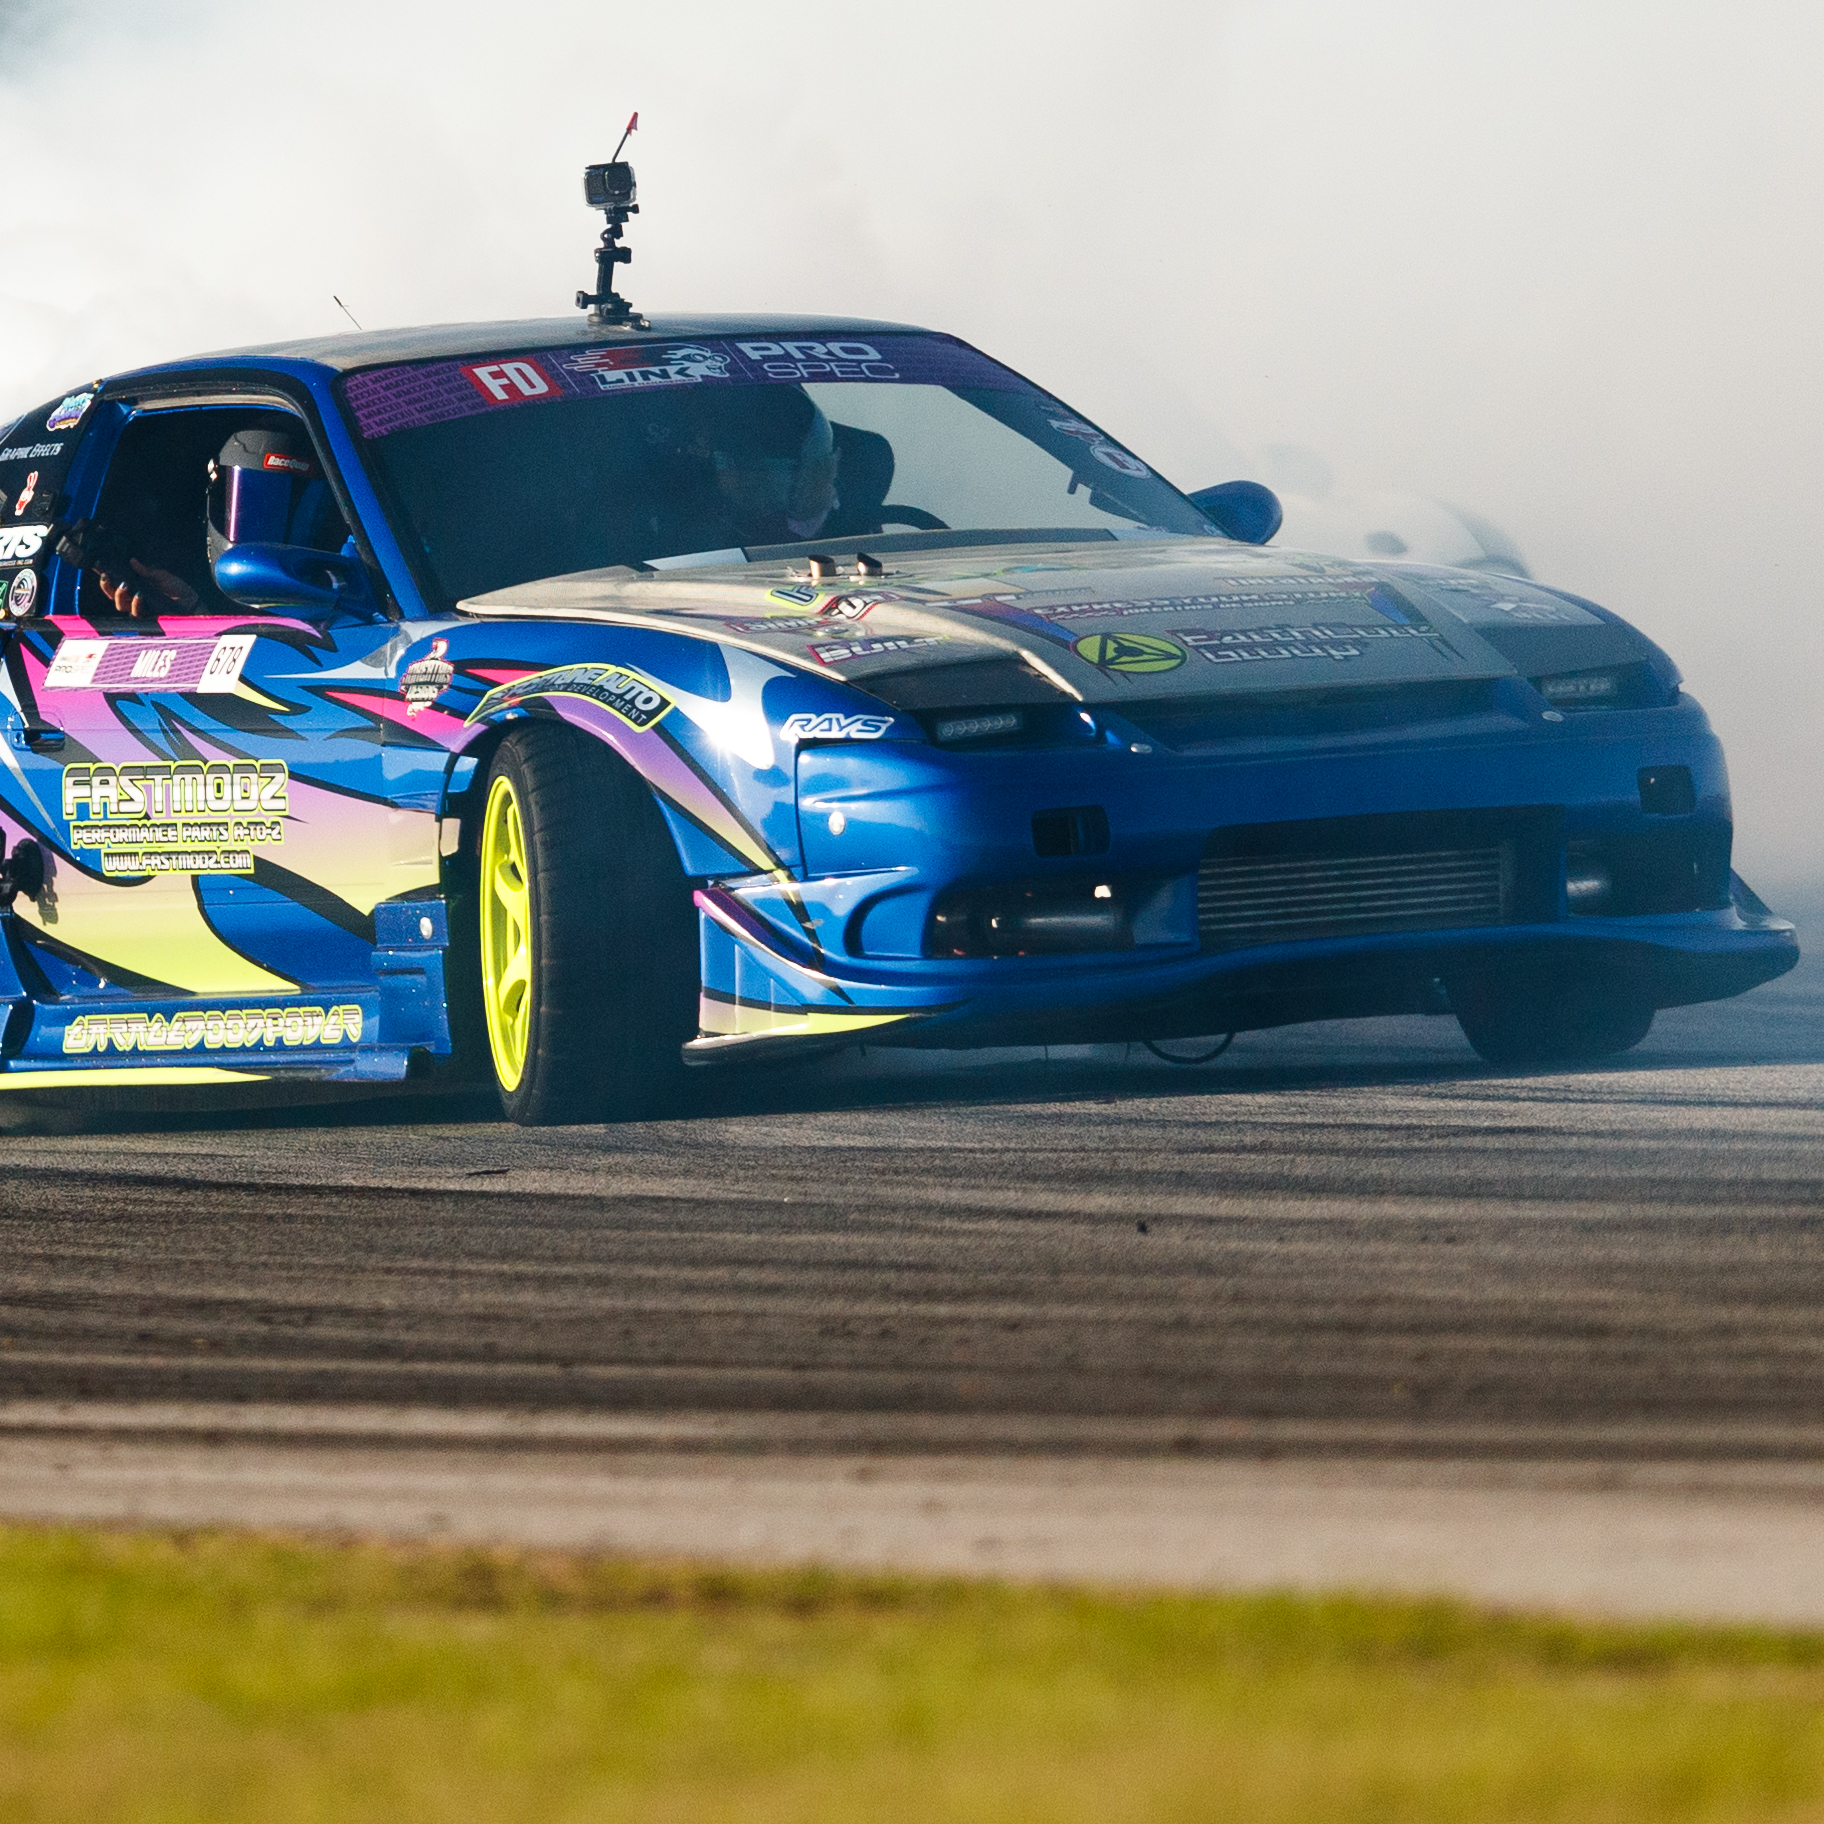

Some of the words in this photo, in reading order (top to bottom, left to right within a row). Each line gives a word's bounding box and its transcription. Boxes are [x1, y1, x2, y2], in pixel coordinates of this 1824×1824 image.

[736, 342, 882, 360] PRO
[473, 362, 550, 400] FD
[596, 366, 696, 385] LINK
[763, 362, 899, 379] SPEC
[130, 649, 176, 678] MILES
[209, 645, 243, 675] 678
[813, 635, 942, 664] BUILT
[567, 683, 647, 723] DEVELOPMENT
[593, 672, 661, 712] AUTO
[780, 713, 894, 743] RAYS
[66, 763, 287, 815] FASTMODZ
[73, 823, 178, 844] PERFORMANCE
[182, 821, 229, 842] PARTS
[233, 820, 282, 841] A-TO-Z
[104, 850, 252, 871] WWW.FASTMODZ.COM
